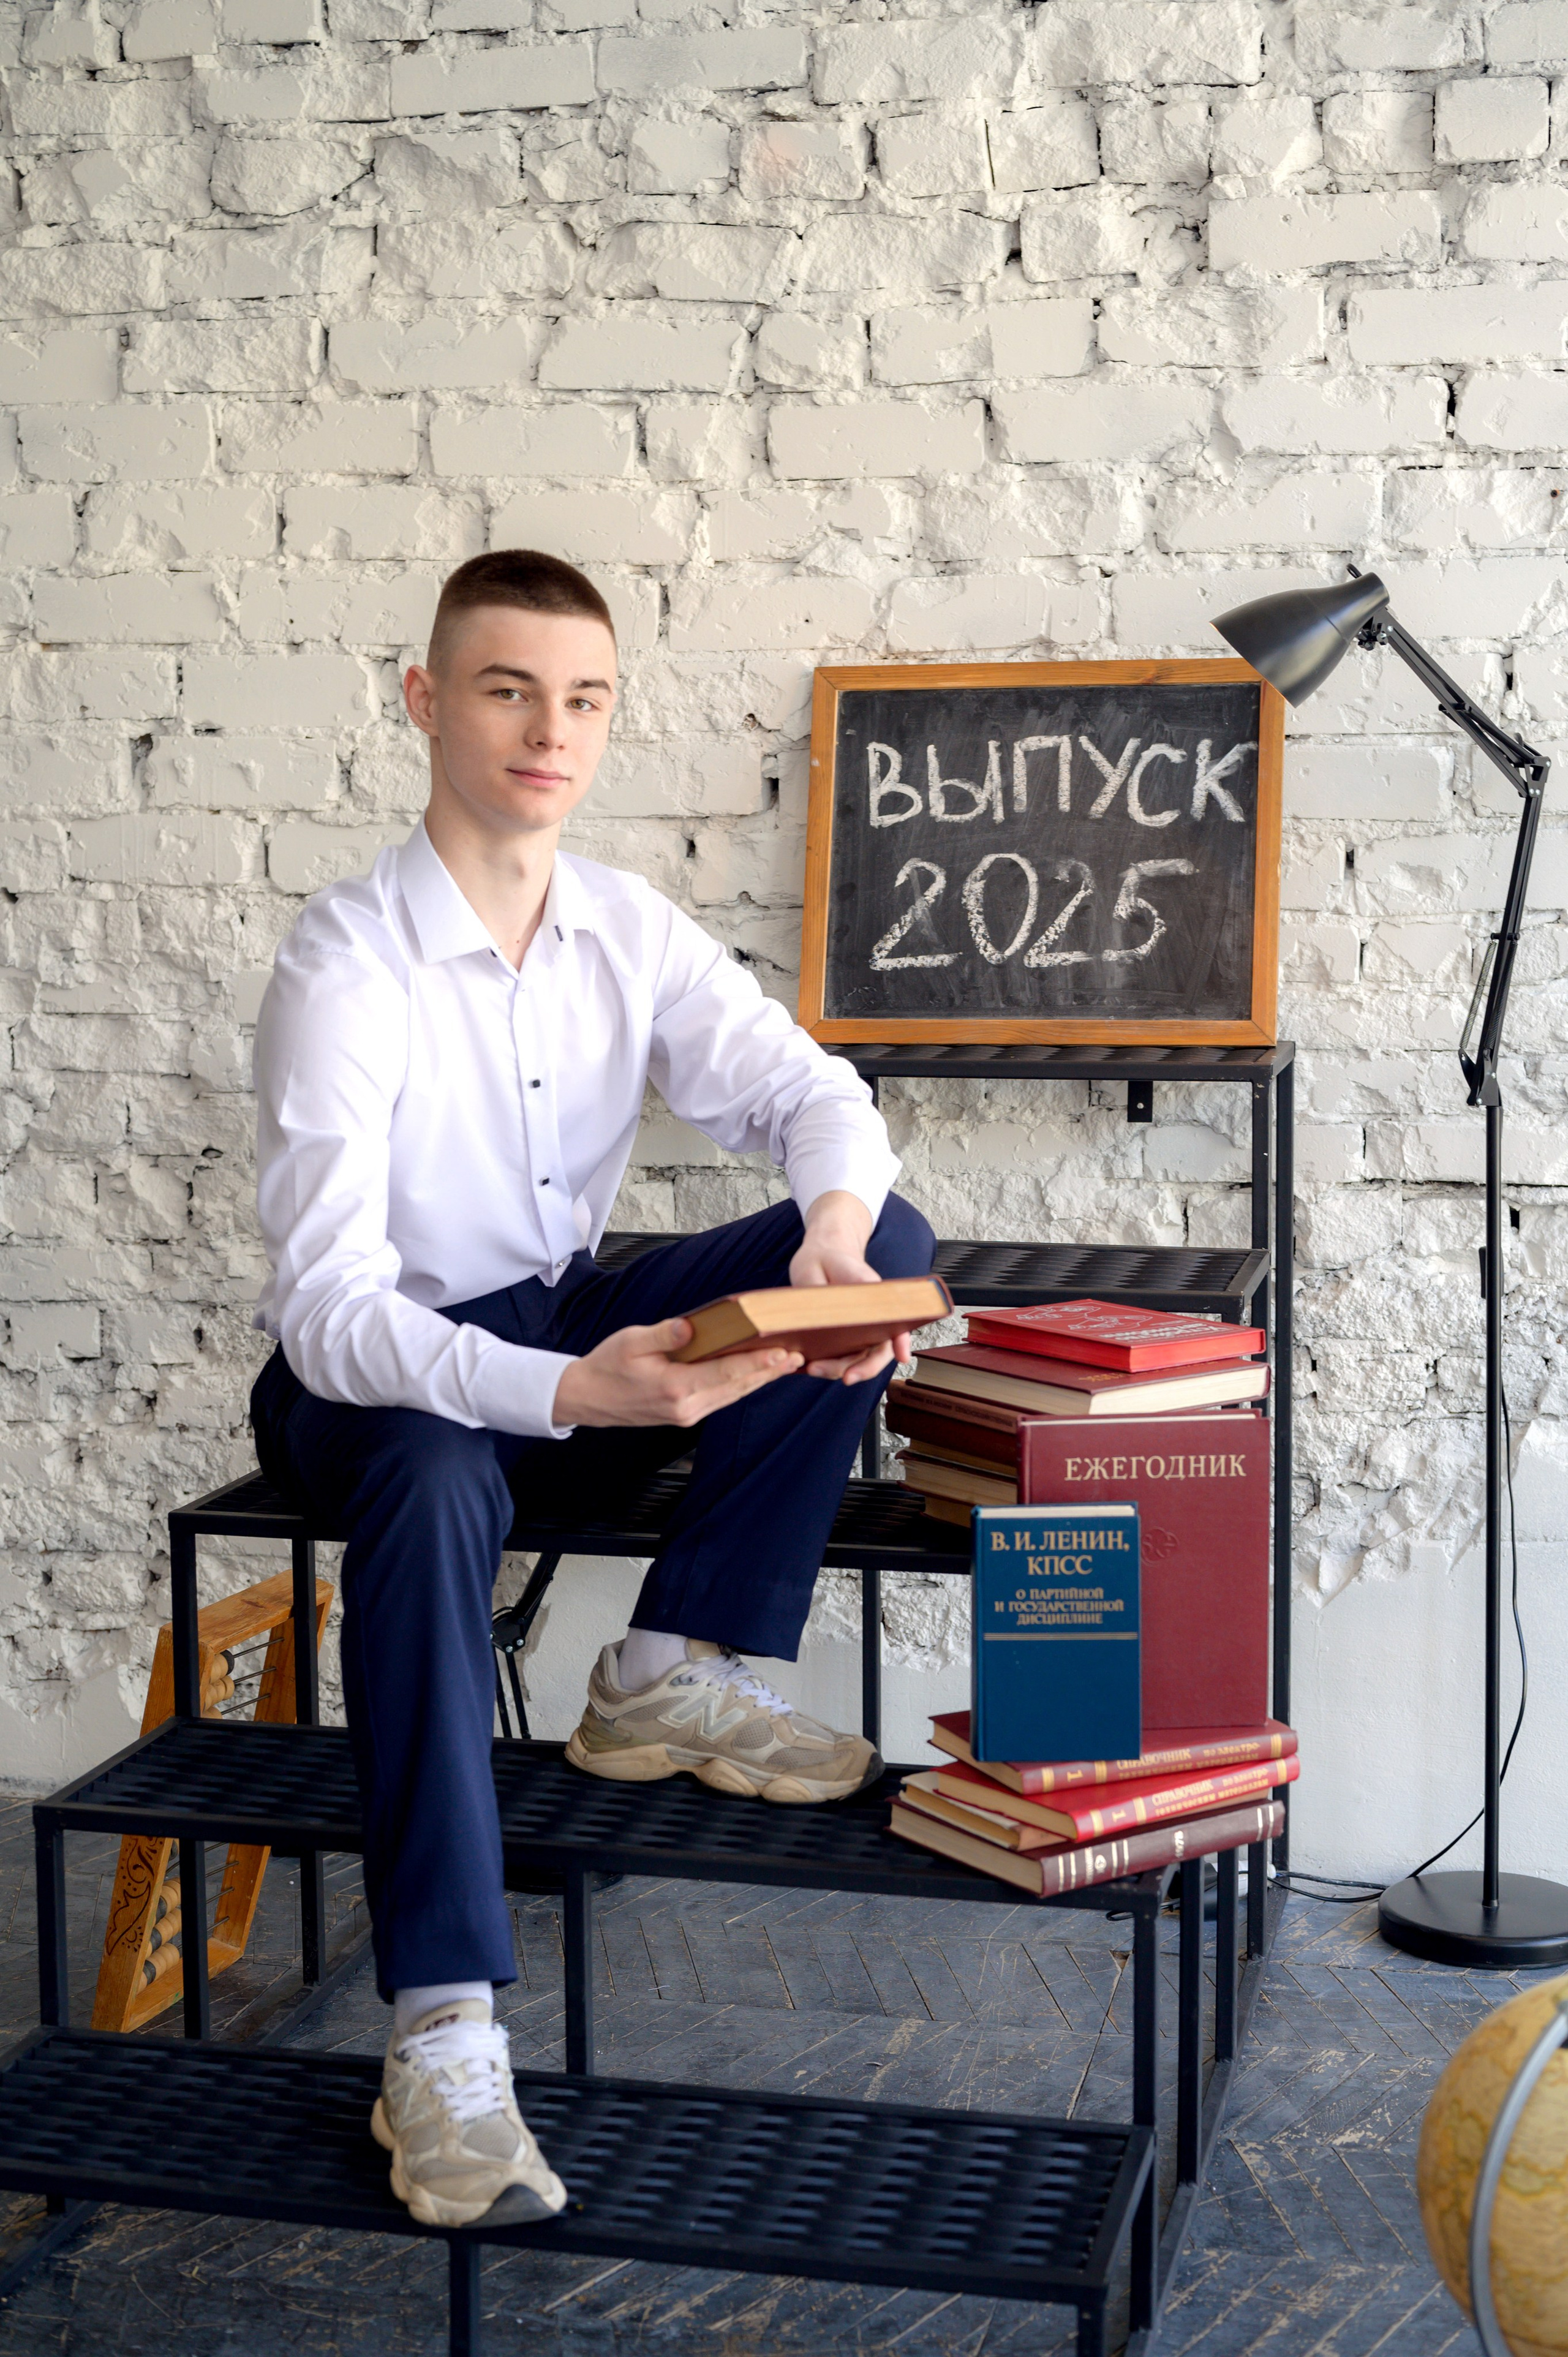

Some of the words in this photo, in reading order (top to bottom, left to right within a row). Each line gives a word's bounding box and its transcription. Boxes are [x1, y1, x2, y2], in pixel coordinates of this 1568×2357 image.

[866, 734, 1259, 828] ВЫПУСК
[869, 853, 1199, 971] 2025
[1064, 1454, 1247, 1482] ЕЖЕГОДНИК
[990, 1531, 1010, 1551] В.
[1014, 1531, 1036, 1551] И.
[1039, 1531, 1130, 1552] ЛЕНИН,
[1027, 1555, 1093, 1575] КПСС
[1016, 1589, 1027, 1600] О
[1030, 1587, 1104, 1600] ПАРТИЙНОЙ
[994, 1601, 1004, 1612] И
[1008, 1599, 1124, 1612] ГОСУДАРСТВЕННОЙ
[1016, 1613, 1103, 1626] ДИСЦИПЛИНЕ
[1117, 1748, 1192, 1770] СПРАВОЧНИК
[1152, 1779, 1214, 1806] СПРАВОЧНИК
